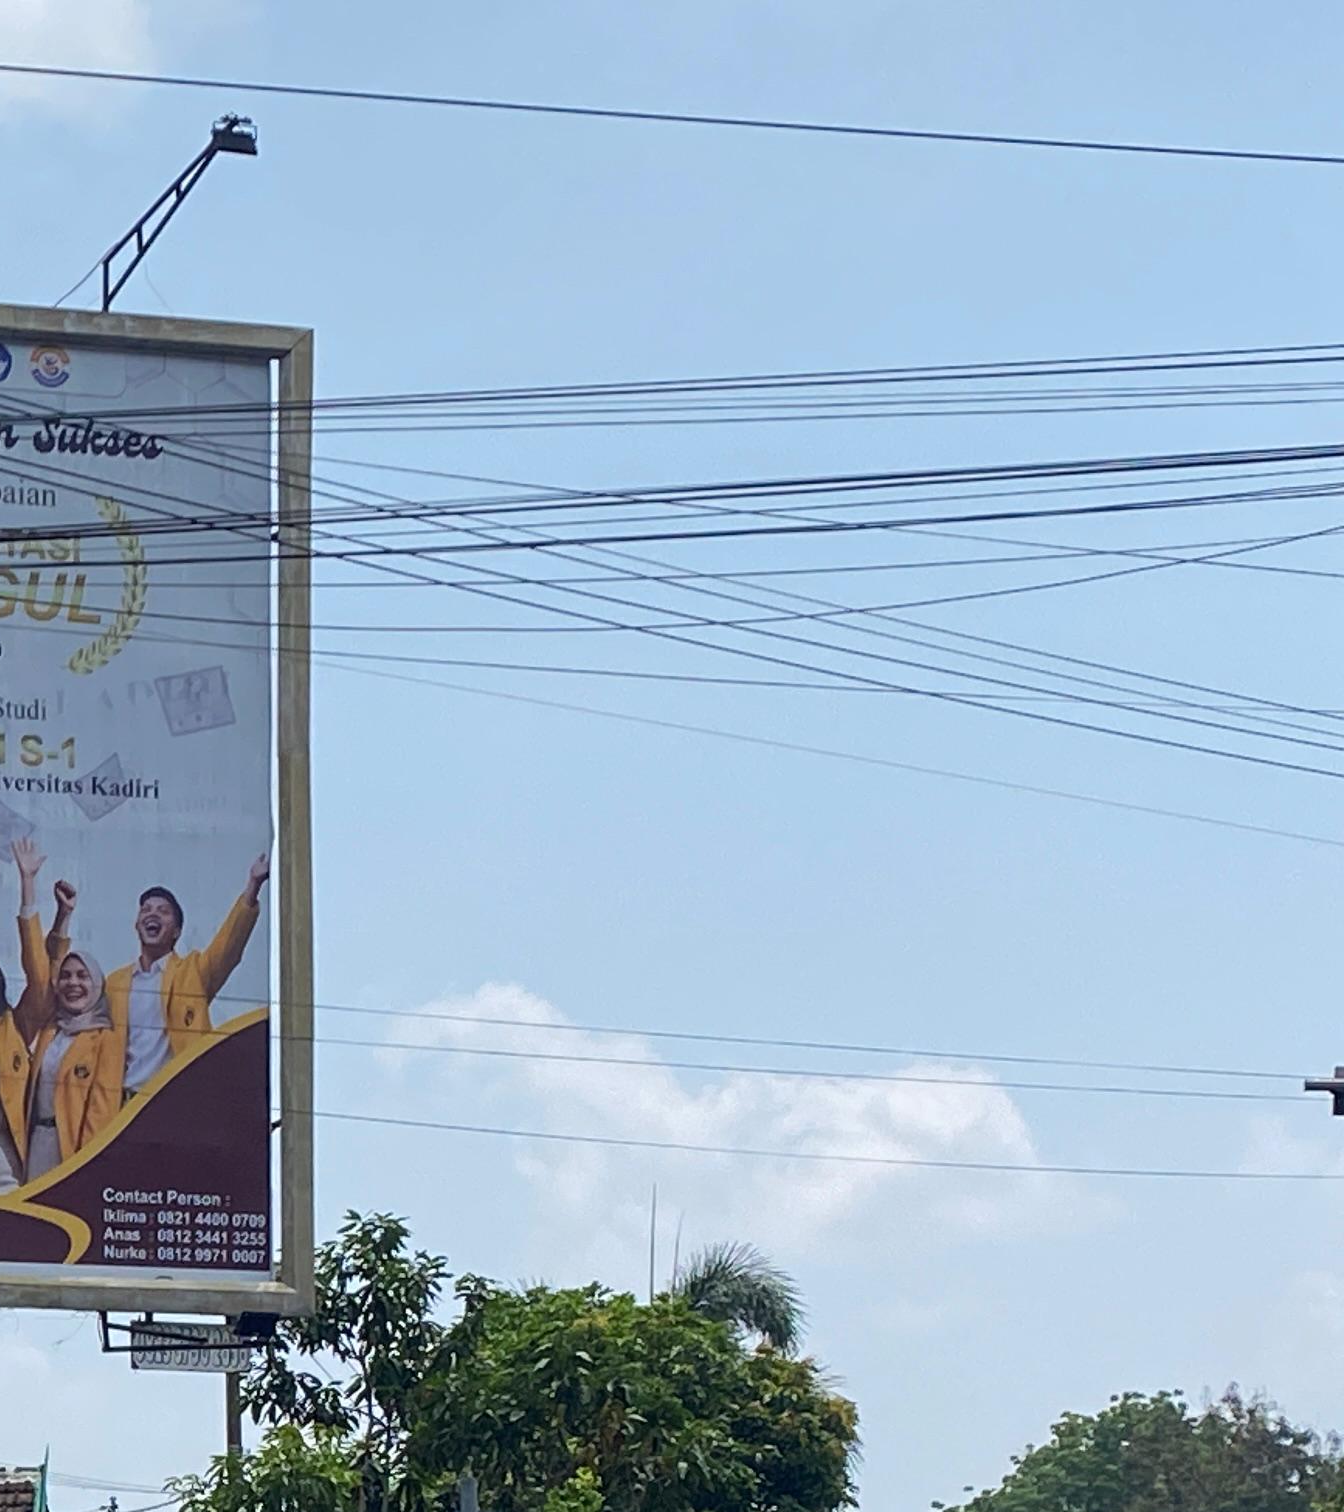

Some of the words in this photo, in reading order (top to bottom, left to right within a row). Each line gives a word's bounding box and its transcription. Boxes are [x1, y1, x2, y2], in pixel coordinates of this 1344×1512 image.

[33, 417, 164, 459] Sukses
[19, 734, 76, 769] S-1
[91, 777, 160, 800] Kadiri
[102, 1187, 162, 1205] Contact
[167, 1190, 221, 1207] Person
[103, 1226, 141, 1242] Anas
[232, 1231, 267, 1246] 3255
